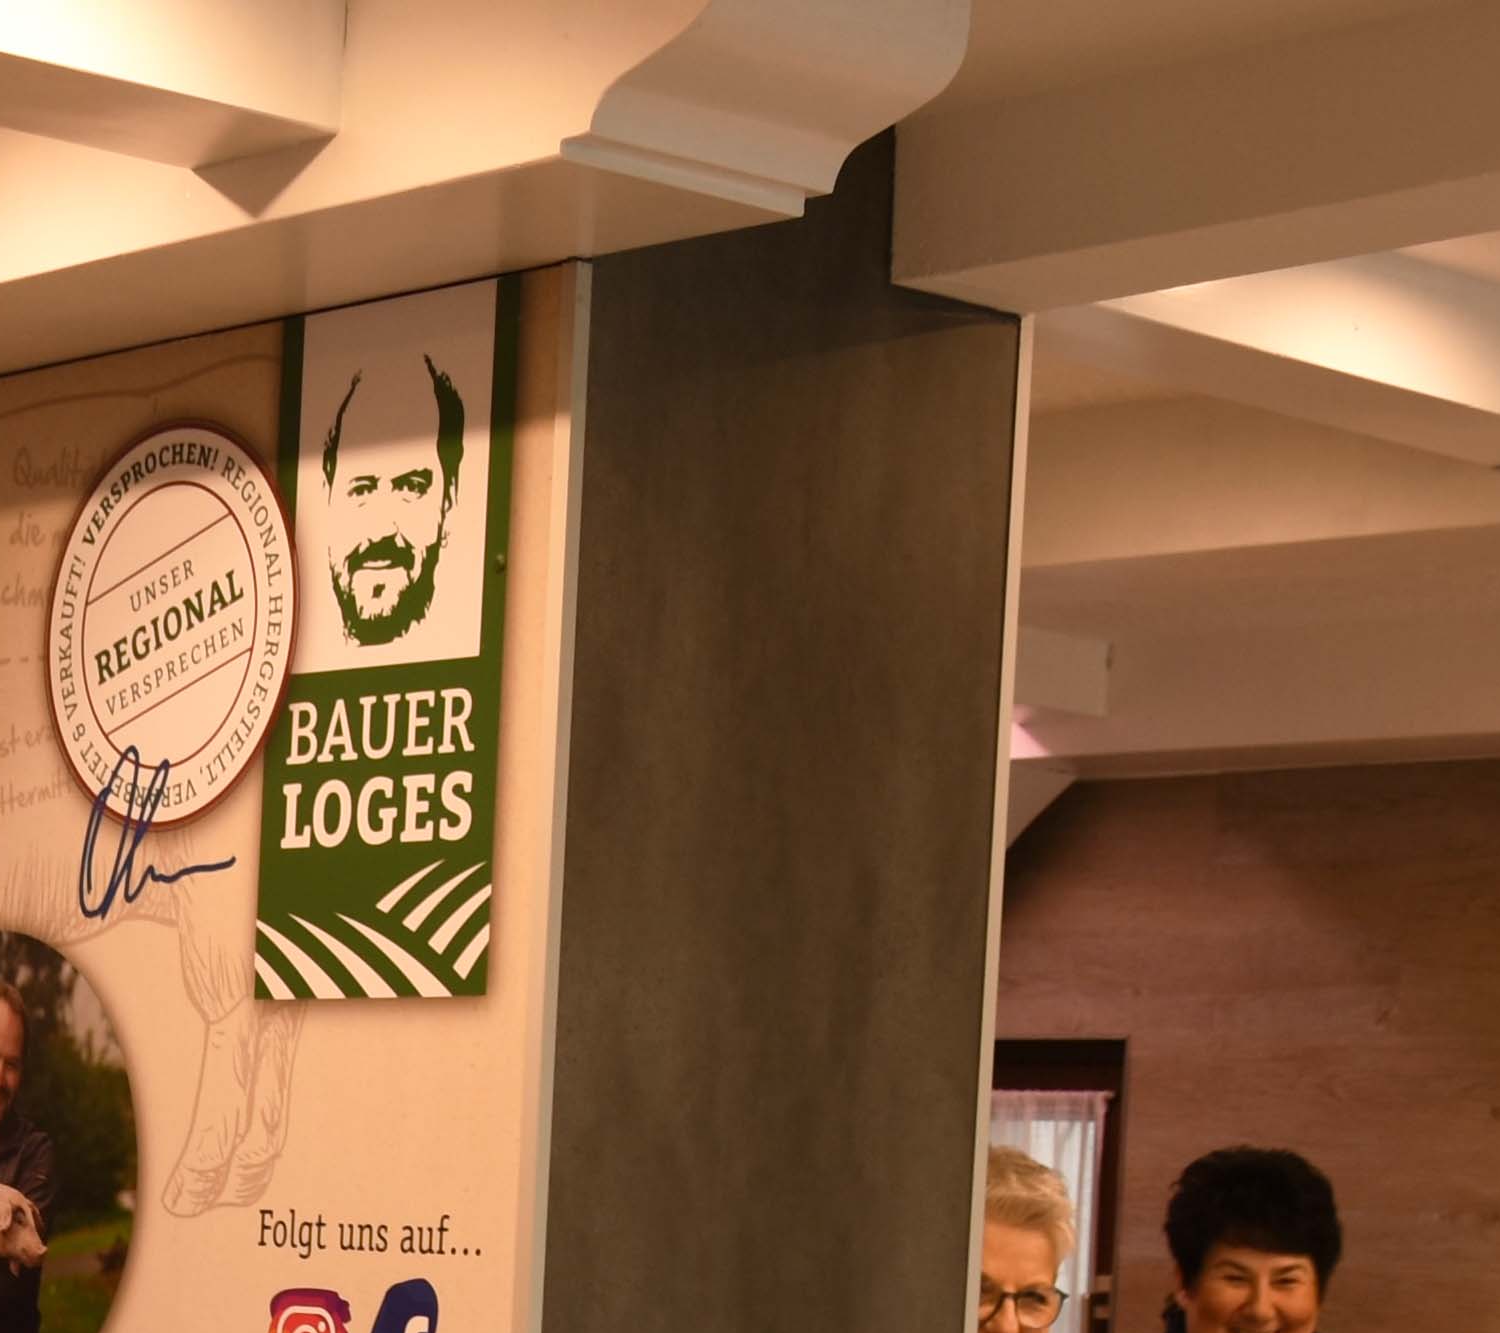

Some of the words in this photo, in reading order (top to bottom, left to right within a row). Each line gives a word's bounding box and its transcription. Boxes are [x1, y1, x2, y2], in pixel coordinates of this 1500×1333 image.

[82, 441, 219, 547] VERSPROCHEN!
[221, 456, 283, 587] REGIONAL
[94, 569, 244, 685] REGIONAL
[129, 559, 195, 612] UNSER
[59, 555, 86, 721] VERKAUFT!
[105, 618, 246, 716] VERSPRECHEN
[285, 687, 475, 765] BAUER
[280, 770, 473, 849] LOGES
[257, 1209, 327, 1259] Folgt
[338, 1221, 388, 1254] uns
[399, 1214, 483, 1256] auf...
